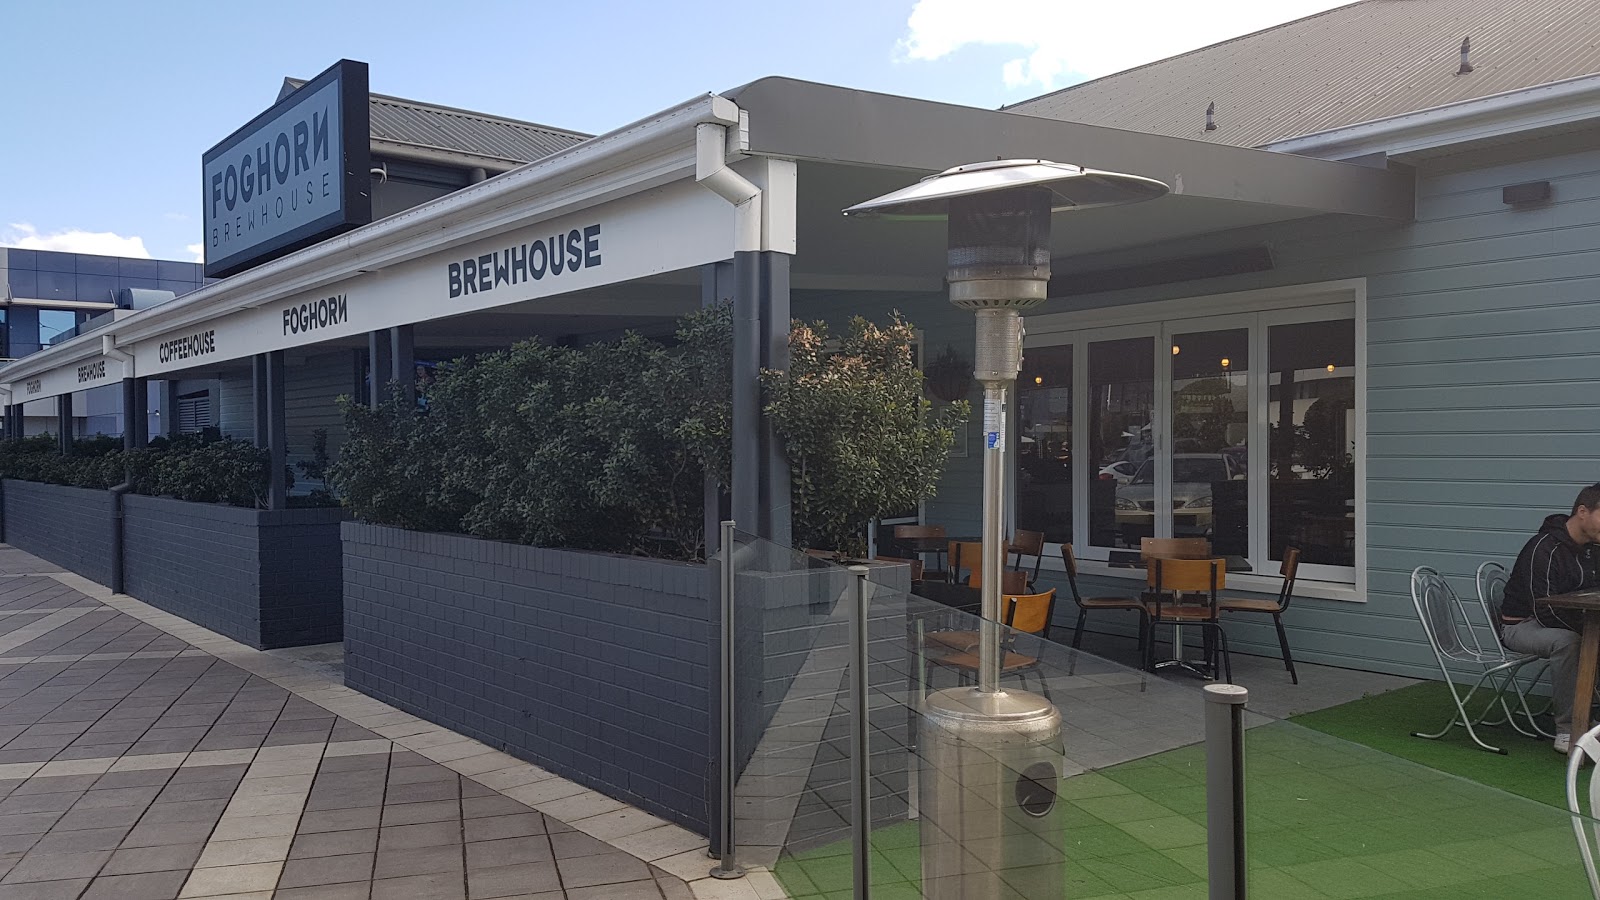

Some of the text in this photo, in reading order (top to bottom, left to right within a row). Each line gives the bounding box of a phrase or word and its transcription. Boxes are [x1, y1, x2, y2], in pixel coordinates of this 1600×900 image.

[212, 172, 330, 248] BREWHOUSE
[448, 224, 602, 299] BREWHOUSE
[77, 361, 105, 383] BREWHOUSE
[159, 330, 215, 364] COFFEEHOUSE
